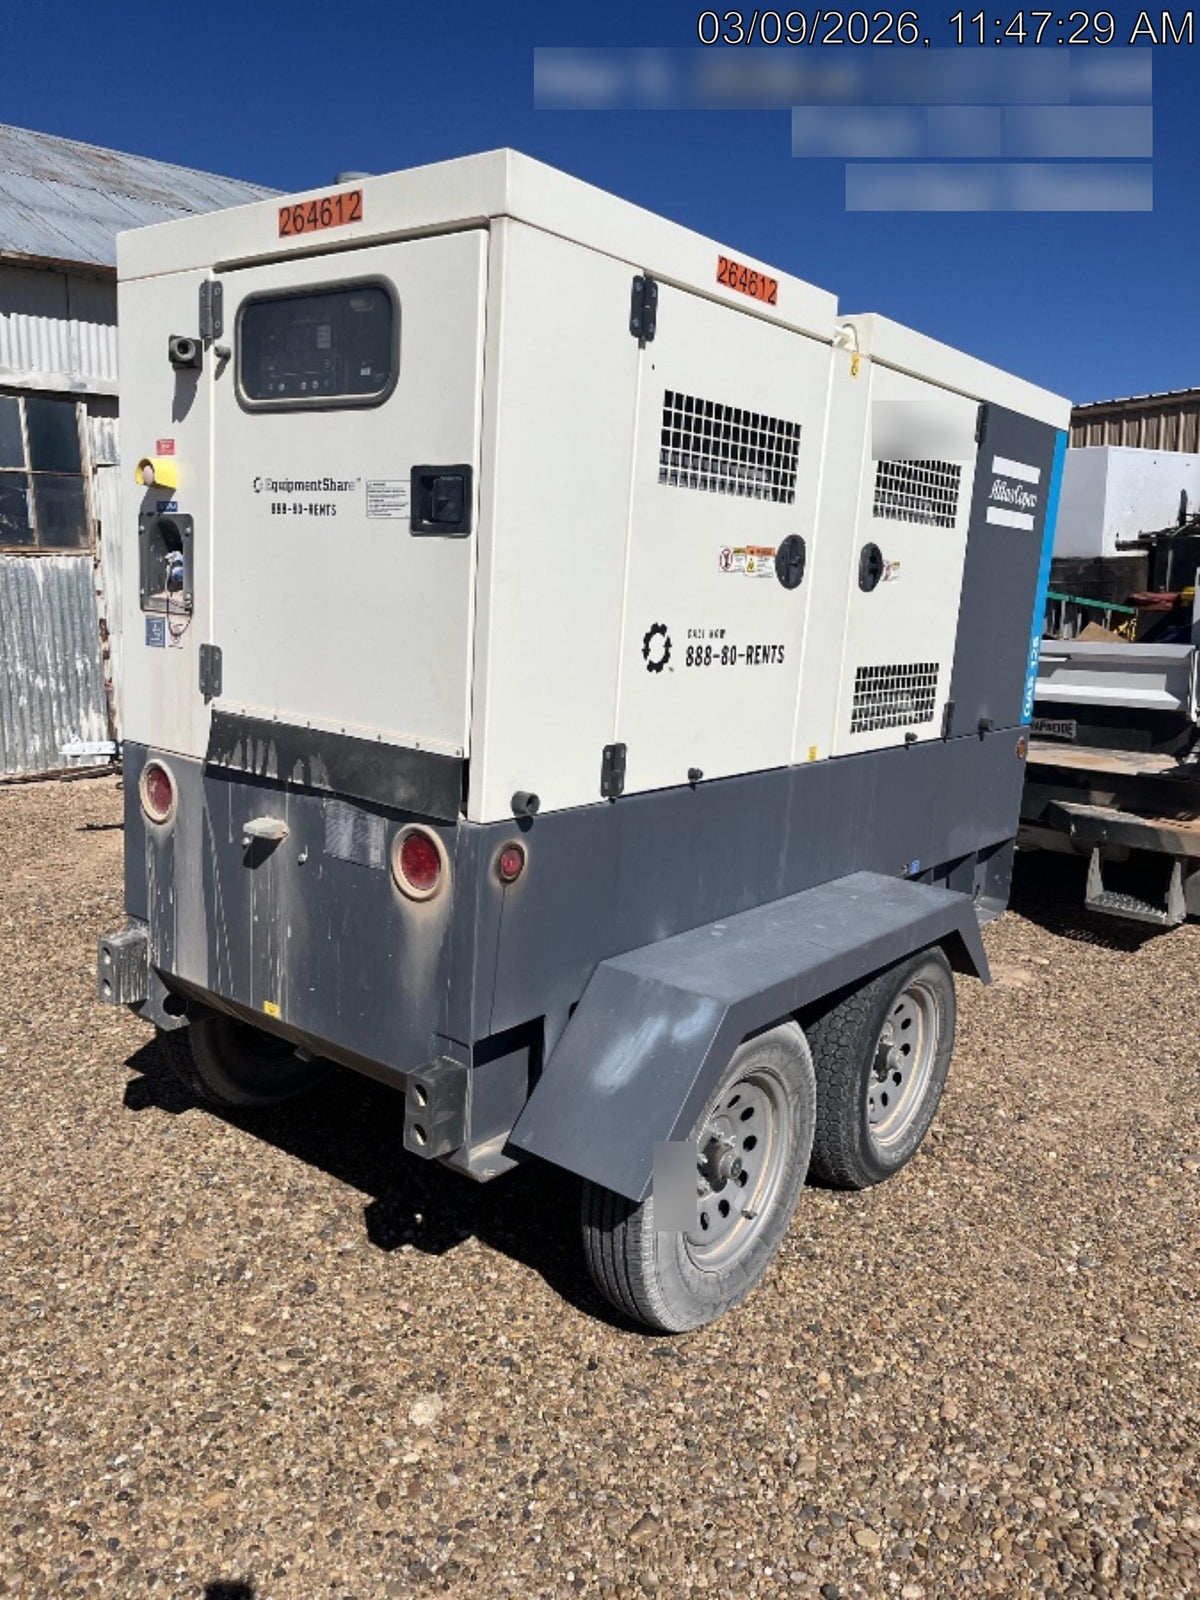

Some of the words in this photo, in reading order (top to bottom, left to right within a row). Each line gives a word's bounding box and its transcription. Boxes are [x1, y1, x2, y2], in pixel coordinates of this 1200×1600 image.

[280, 190, 362, 235] 264612
[717, 257, 778, 306] 264612
[686, 645, 785, 667] 888-80-RENTS
